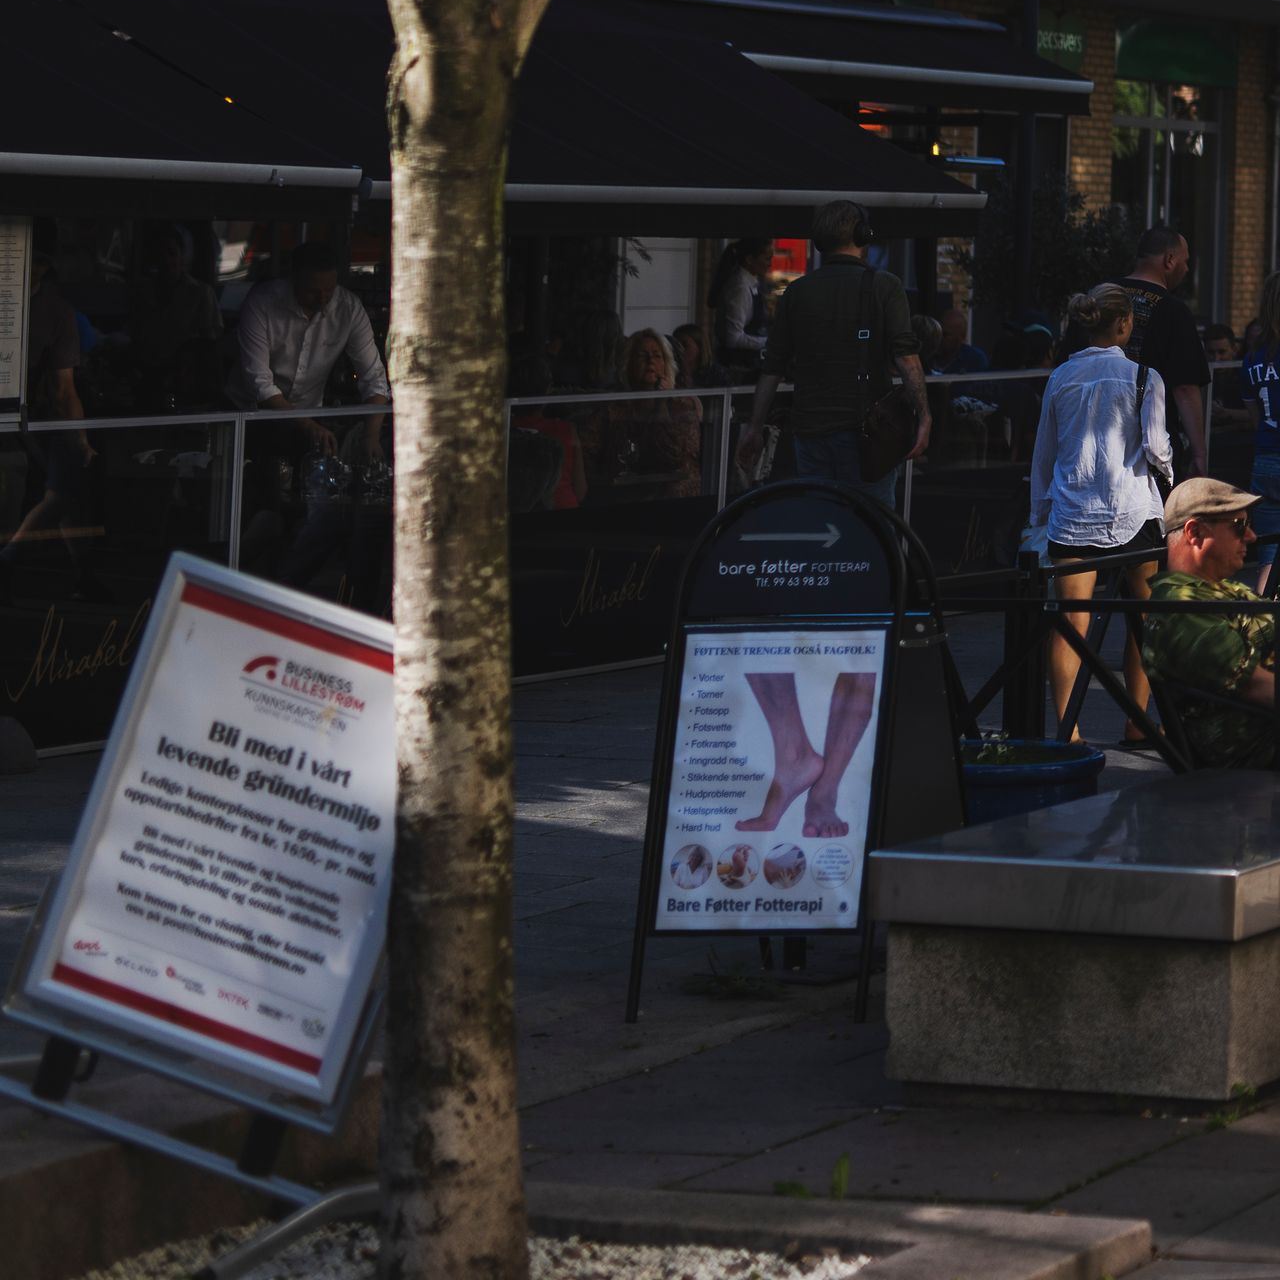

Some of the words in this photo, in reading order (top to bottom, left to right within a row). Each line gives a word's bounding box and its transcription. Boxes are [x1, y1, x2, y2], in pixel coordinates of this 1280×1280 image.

[1036, 29, 1082, 53] pecsavers
[719, 561, 757, 576] bare
[761, 559, 808, 574] føtter
[811, 561, 870, 573] FOTTERAPI
[755, 577, 770, 588] Tlf.
[773, 577, 785, 587] 99
[787, 577, 800, 587] 63
[802, 576, 815, 586] 98
[817, 576, 830, 586] 23
[693, 646, 741, 657] FØTTENE
[743, 646, 792, 657] TRENGER
[793, 644, 821, 656] OGSÅ
[823, 644, 877, 656] FAGFOLK!
[284, 660, 354, 694] BUSINESS
[698, 673, 725, 682] Vorter
[280, 674, 366, 713] LILLESTRØM
[694, 706, 730, 717] Fotsopp
[692, 722, 733, 732] Fotsvette
[690, 739, 737, 750] Fotkrampe
[207, 721, 241, 748] Bli
[243, 735, 293, 766] med
[296, 751, 308, 771] i
[311, 759, 352, 789] vårt
[688, 756, 727, 767] Inngrodd
[728, 755, 748, 767] negl
[156, 736, 240, 781] levende
[243, 769, 382, 832] gründermiljø
[686, 772, 730, 782] Stikkende
[731, 772, 766, 782] smerter
[685, 789, 747, 800] Hudproblemer
[140, 770, 183, 796] Ledige
[186, 786, 275, 828] kontorplasser
[297, 827, 355, 859] gründere
[358, 850, 376, 867] og
[239, 824, 260, 845] fra
[681, 823, 703, 833] Hard
[704, 823, 722, 833] hud
[160, 830, 186, 850] med
[666, 897, 701, 913] Bare
[704, 897, 751, 914] Føtter
[754, 897, 823, 915] Fotterapi
